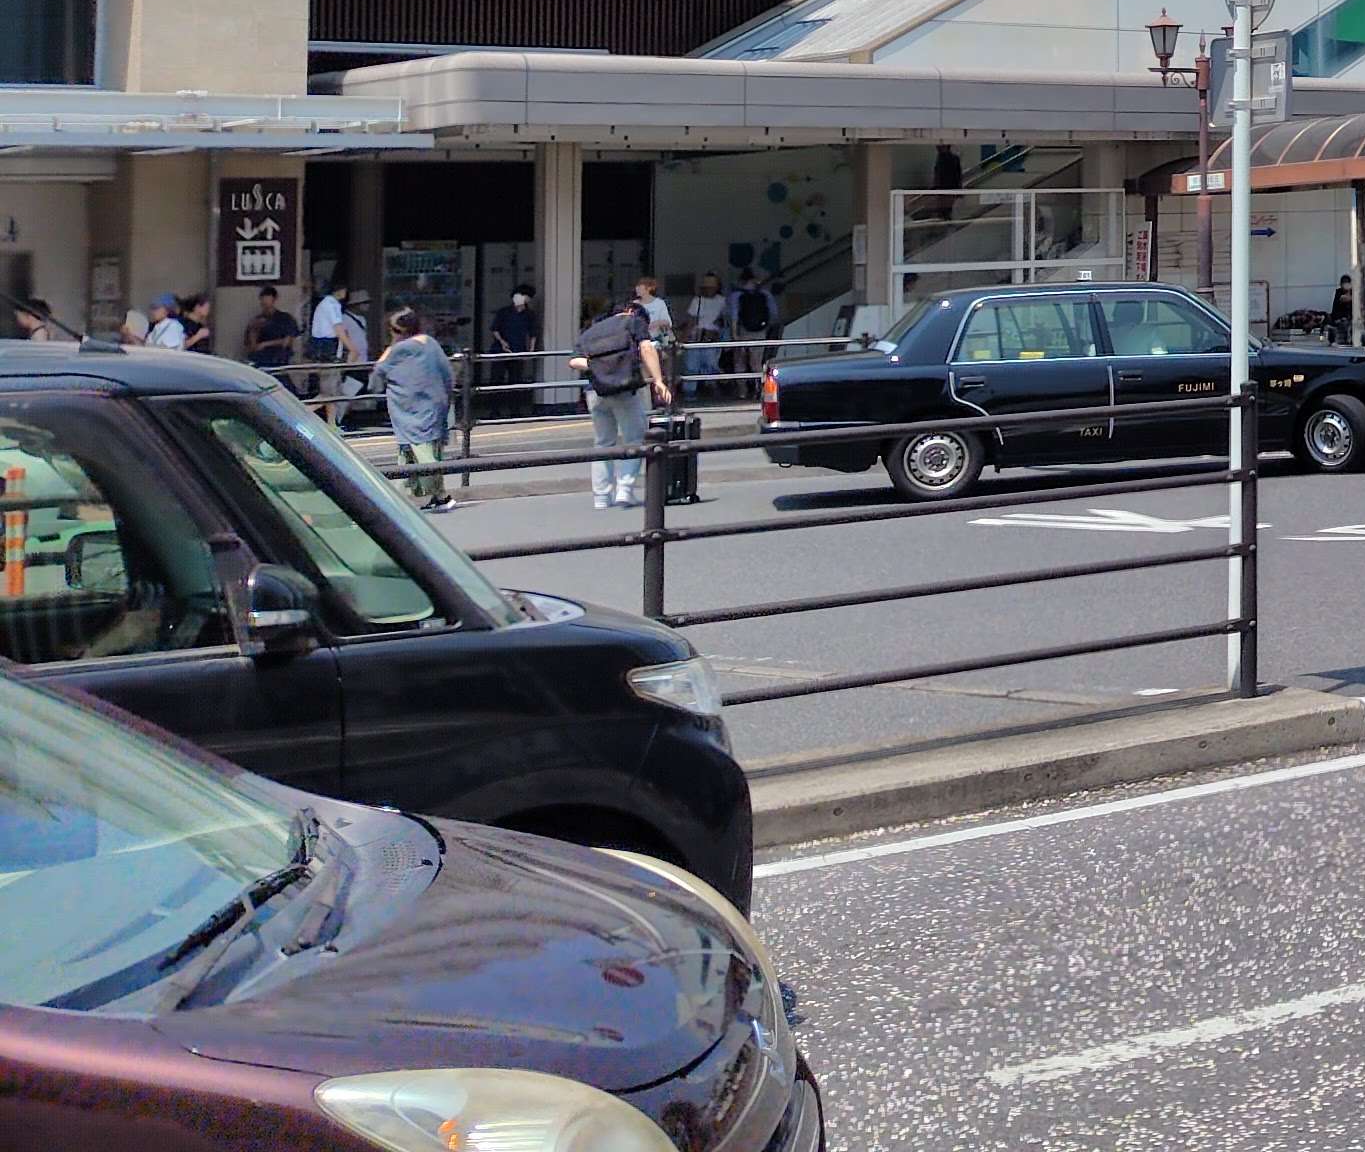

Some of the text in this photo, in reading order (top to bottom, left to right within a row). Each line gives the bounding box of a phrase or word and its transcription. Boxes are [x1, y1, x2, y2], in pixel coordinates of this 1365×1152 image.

[231, 183, 286, 210] LUSCA
[1178, 382, 1215, 392] FUJIMI
[1079, 427, 1103, 437] TAXI
